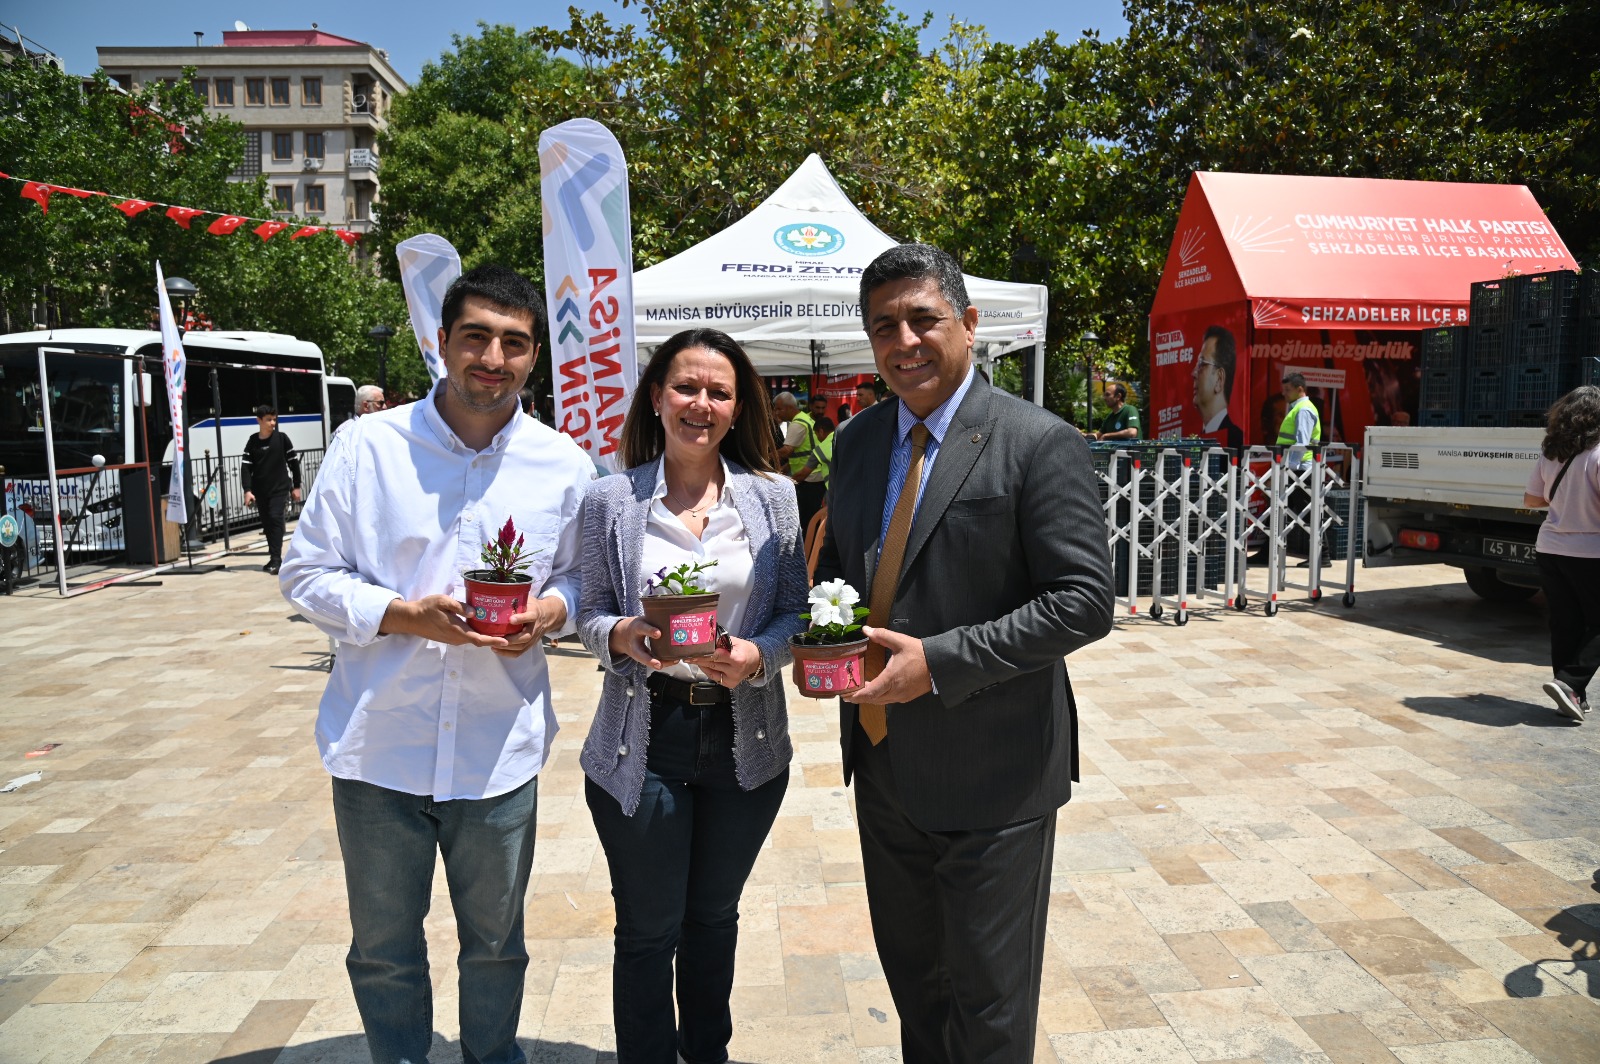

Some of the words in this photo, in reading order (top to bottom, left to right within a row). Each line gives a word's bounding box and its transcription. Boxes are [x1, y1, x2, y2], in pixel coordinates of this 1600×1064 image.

[1422, 218, 1477, 234] HALK
[1302, 229, 1413, 242] TÜRKİYE'NİN
[1421, 233, 1485, 244] BİRİNCİ
[1492, 235, 1557, 246] PARTİSİ
[1308, 242, 1420, 256] ŞEHZADELER
[1422, 243, 1462, 258] İLÇE
[1464, 246, 1566, 260] BAŞKANLIĞI
[798, 266, 863, 274] ZEYR
[1179, 265, 1207, 280] ŞEHZADELER
[646, 304, 700, 320] MANİSA
[705, 301, 792, 320] BÜYÜKŞEHİR
[797, 302, 862, 316] BELEDİYE
[1302, 306, 1410, 323] ŞEHZADELER
[1417, 305, 1450, 324] İLÇE
[1463, 450, 1514, 460] BÜYÜKŞEHİR
[1490, 542, 1504, 554] 45
[1510, 544, 1517, 556] M
[1524, 546, 1536, 560] 25
